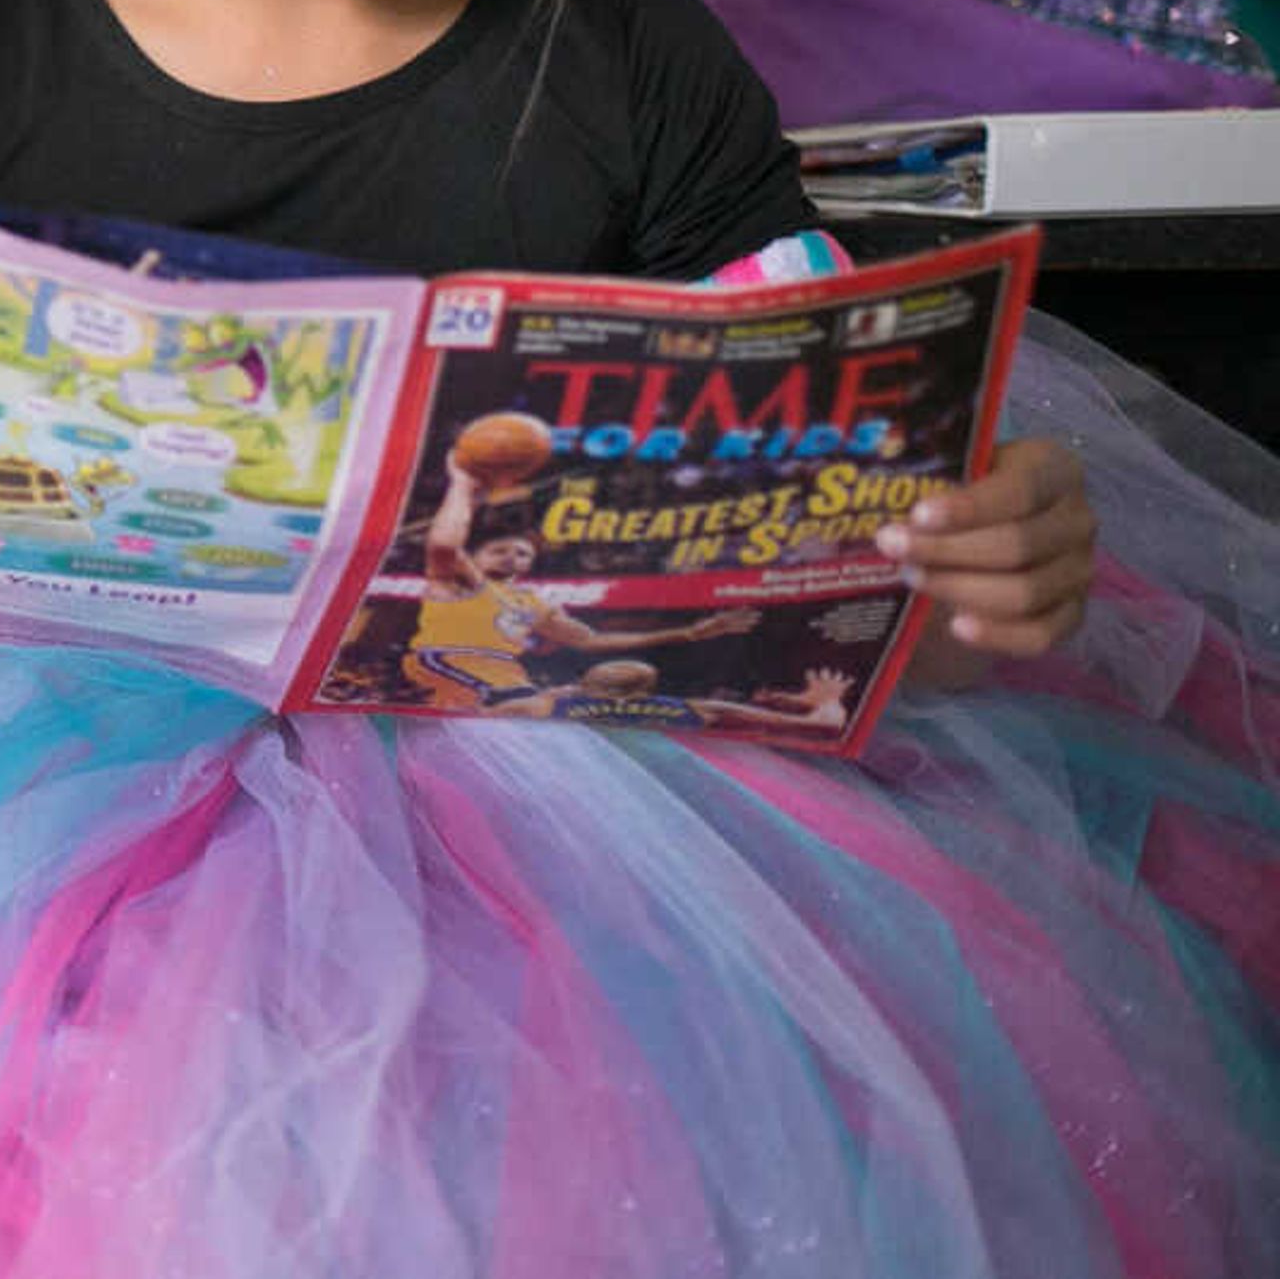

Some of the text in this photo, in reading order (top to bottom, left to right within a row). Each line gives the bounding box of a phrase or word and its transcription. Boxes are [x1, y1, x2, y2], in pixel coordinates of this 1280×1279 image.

[437, 307, 490, 332] 20
[527, 346, 921, 443] TIME
[711, 417, 891, 460] KIDS
[543, 484, 802, 545] GREATEST
[671, 536, 728, 567] IN
